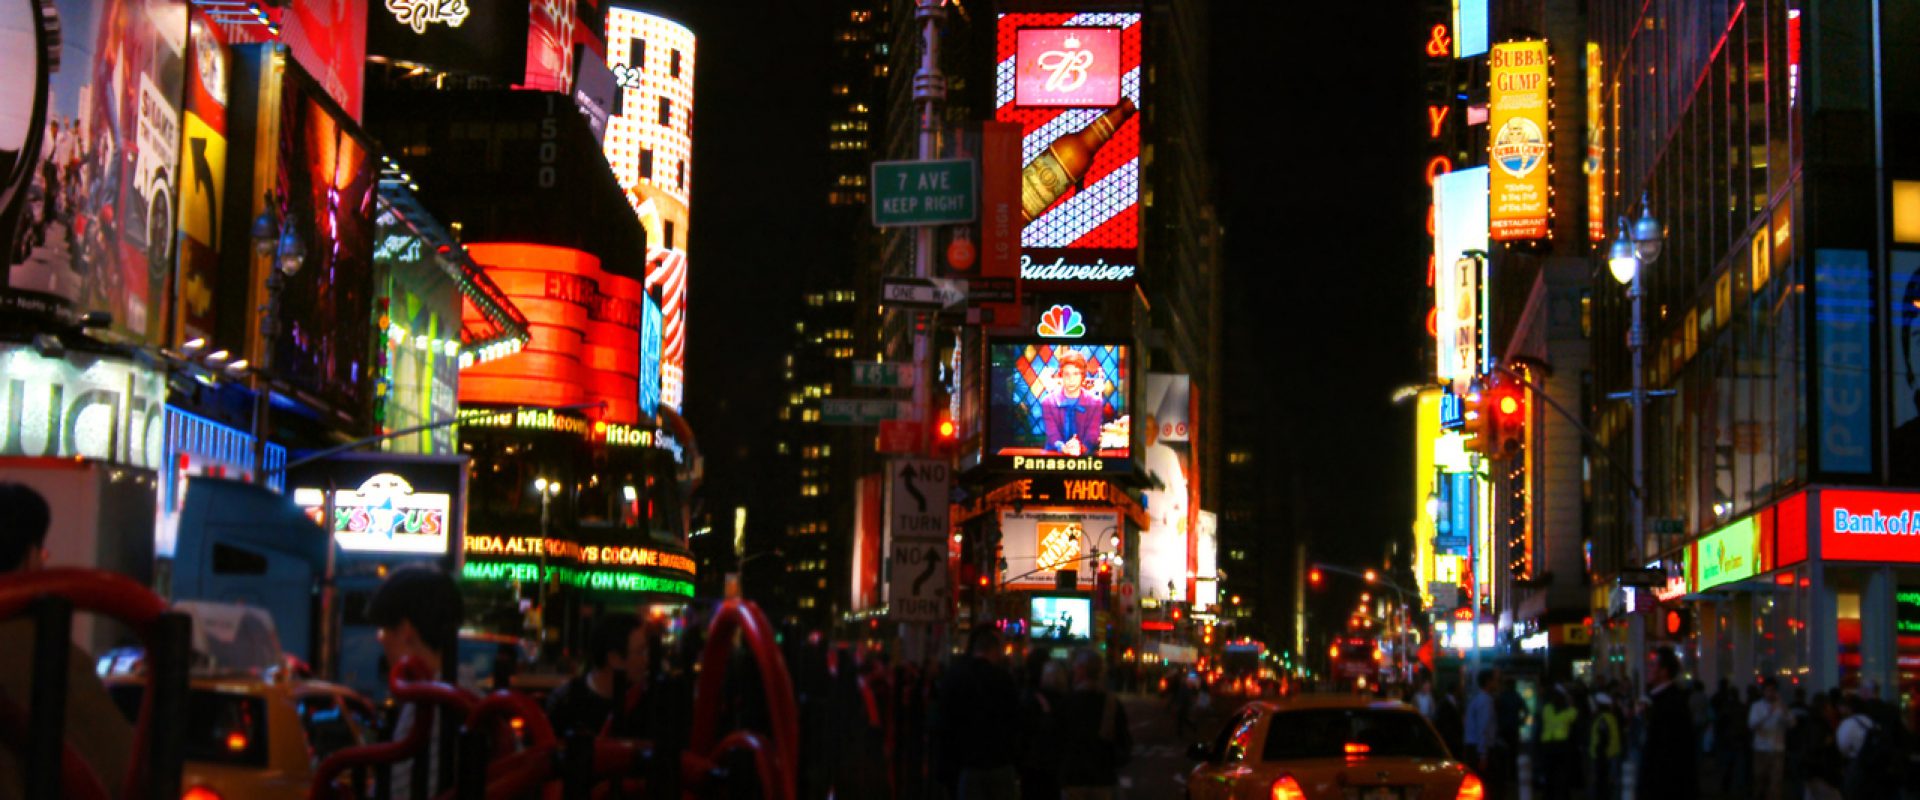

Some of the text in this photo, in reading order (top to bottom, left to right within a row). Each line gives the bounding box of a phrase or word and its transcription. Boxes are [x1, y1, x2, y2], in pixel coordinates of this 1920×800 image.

[1493, 48, 1544, 69] BUBBA
[1497, 72, 1541, 91] GUMP
[898, 171, 950, 191] 7 AVE
[883, 195, 965, 214] KEEP RIGHT
[892, 286, 916, 298] ONE
[1013, 456, 1103, 470] Panasonic
[920, 464, 945, 482] NO
[900, 515, 942, 531] TURN
[1834, 507, 1887, 535] Bank
[1888, 512, 1908, 535] of
[895, 547, 920, 564] NO
[899, 601, 940, 614] TURN
